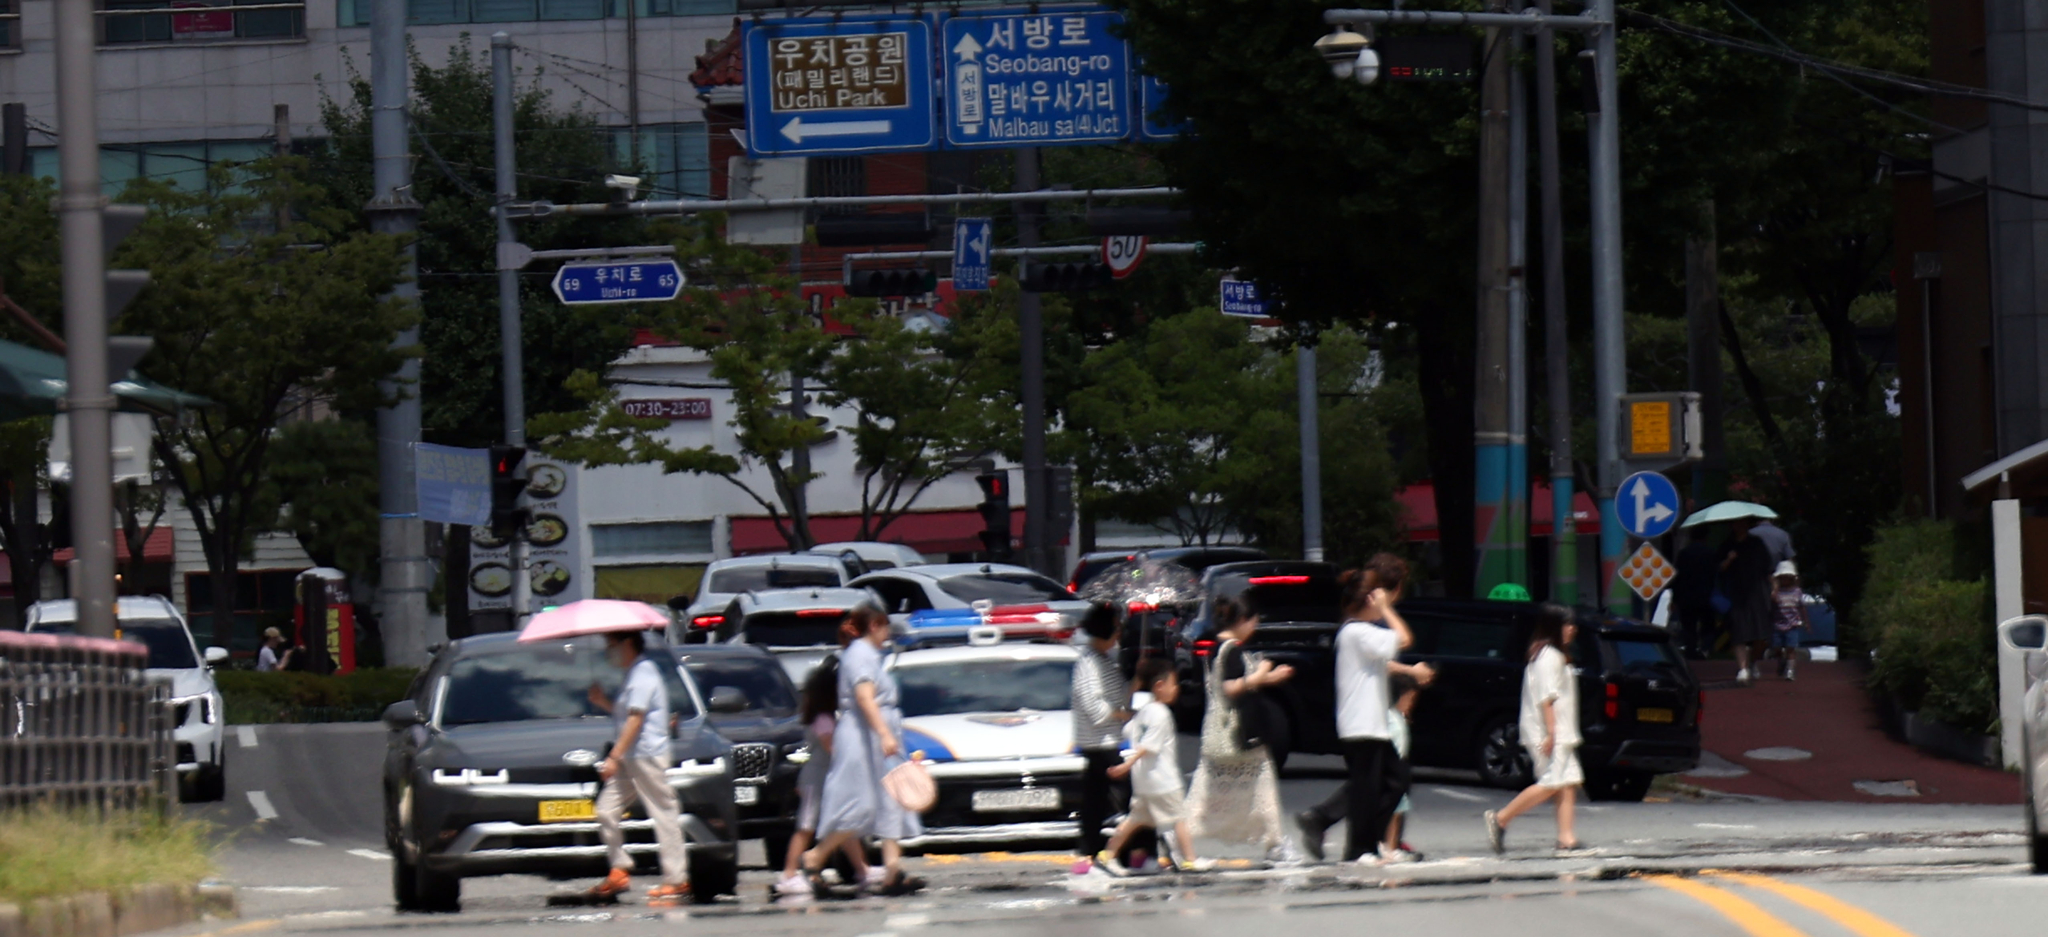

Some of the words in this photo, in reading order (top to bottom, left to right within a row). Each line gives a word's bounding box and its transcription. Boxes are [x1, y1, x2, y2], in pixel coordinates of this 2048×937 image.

[986, 17, 1090, 50] 서방로
[775, 35, 903, 69] 우치공원
[986, 53, 1110, 75] Seobang-ro
[776, 65, 899, 89] (패밀리랜드)
[778, 91, 828, 109] Uchi
[837, 87, 887, 107] Park
[961, 70, 976, 117] 서방로
[988, 78, 1114, 114] 말바우사거리
[989, 118, 1049, 137] Malbau
[1111, 235, 1138, 259] 50
[563, 278, 581, 291] 69
[594, 266, 644, 284] 우치로
[658, 274, 675, 287] 65
[1224, 284, 1255, 300] 서방로
[625, 401, 707, 417] 07:30~23:00
